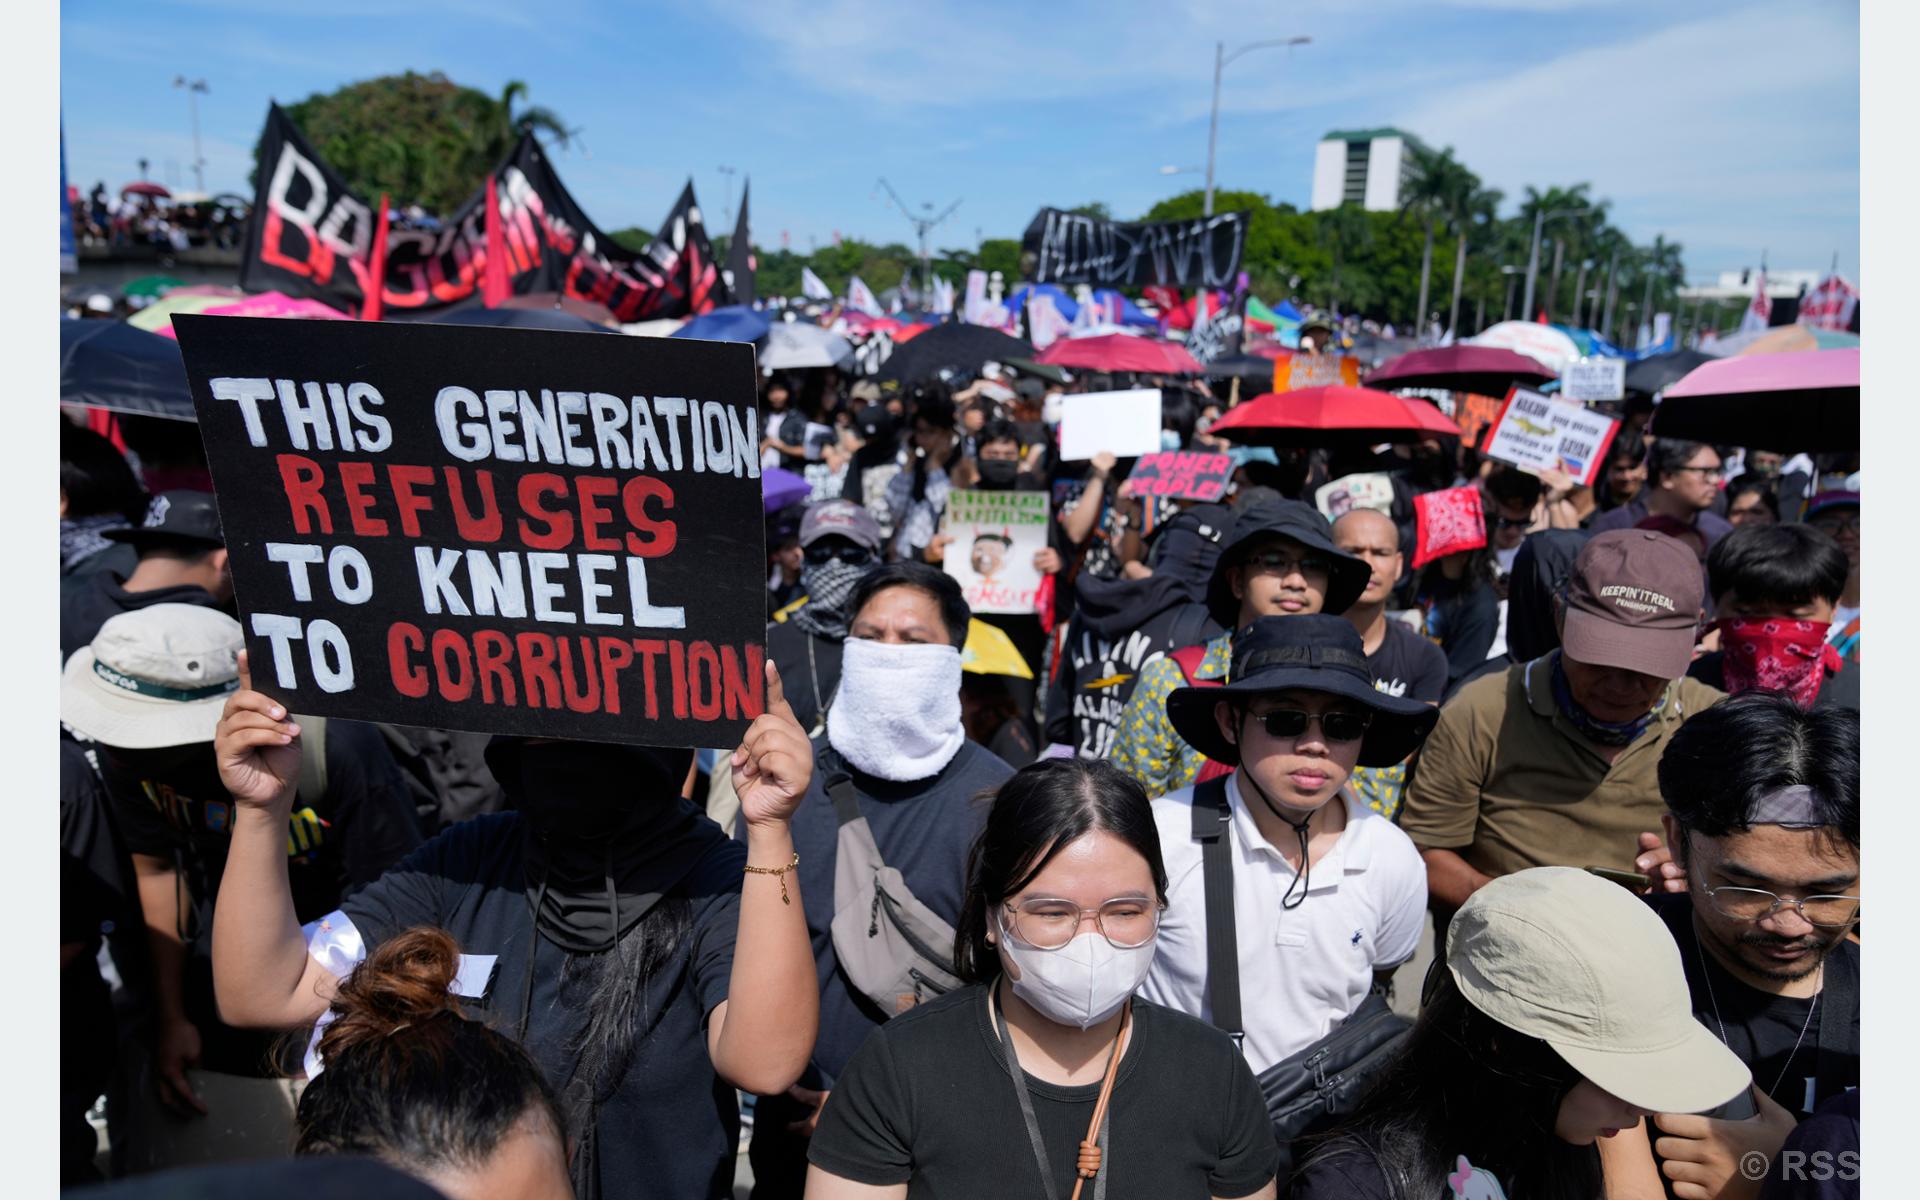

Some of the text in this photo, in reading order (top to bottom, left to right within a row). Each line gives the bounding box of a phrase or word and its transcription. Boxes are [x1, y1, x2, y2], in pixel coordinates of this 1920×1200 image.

[210, 377, 761, 478] THIS GENERATION
[276, 454, 677, 558] REFUSES
[266, 542, 687, 630] TO KNEEL
[1615, 598, 1658, 613] PENSHOPPE
[251, 612, 767, 722] TO CORRUPTION
